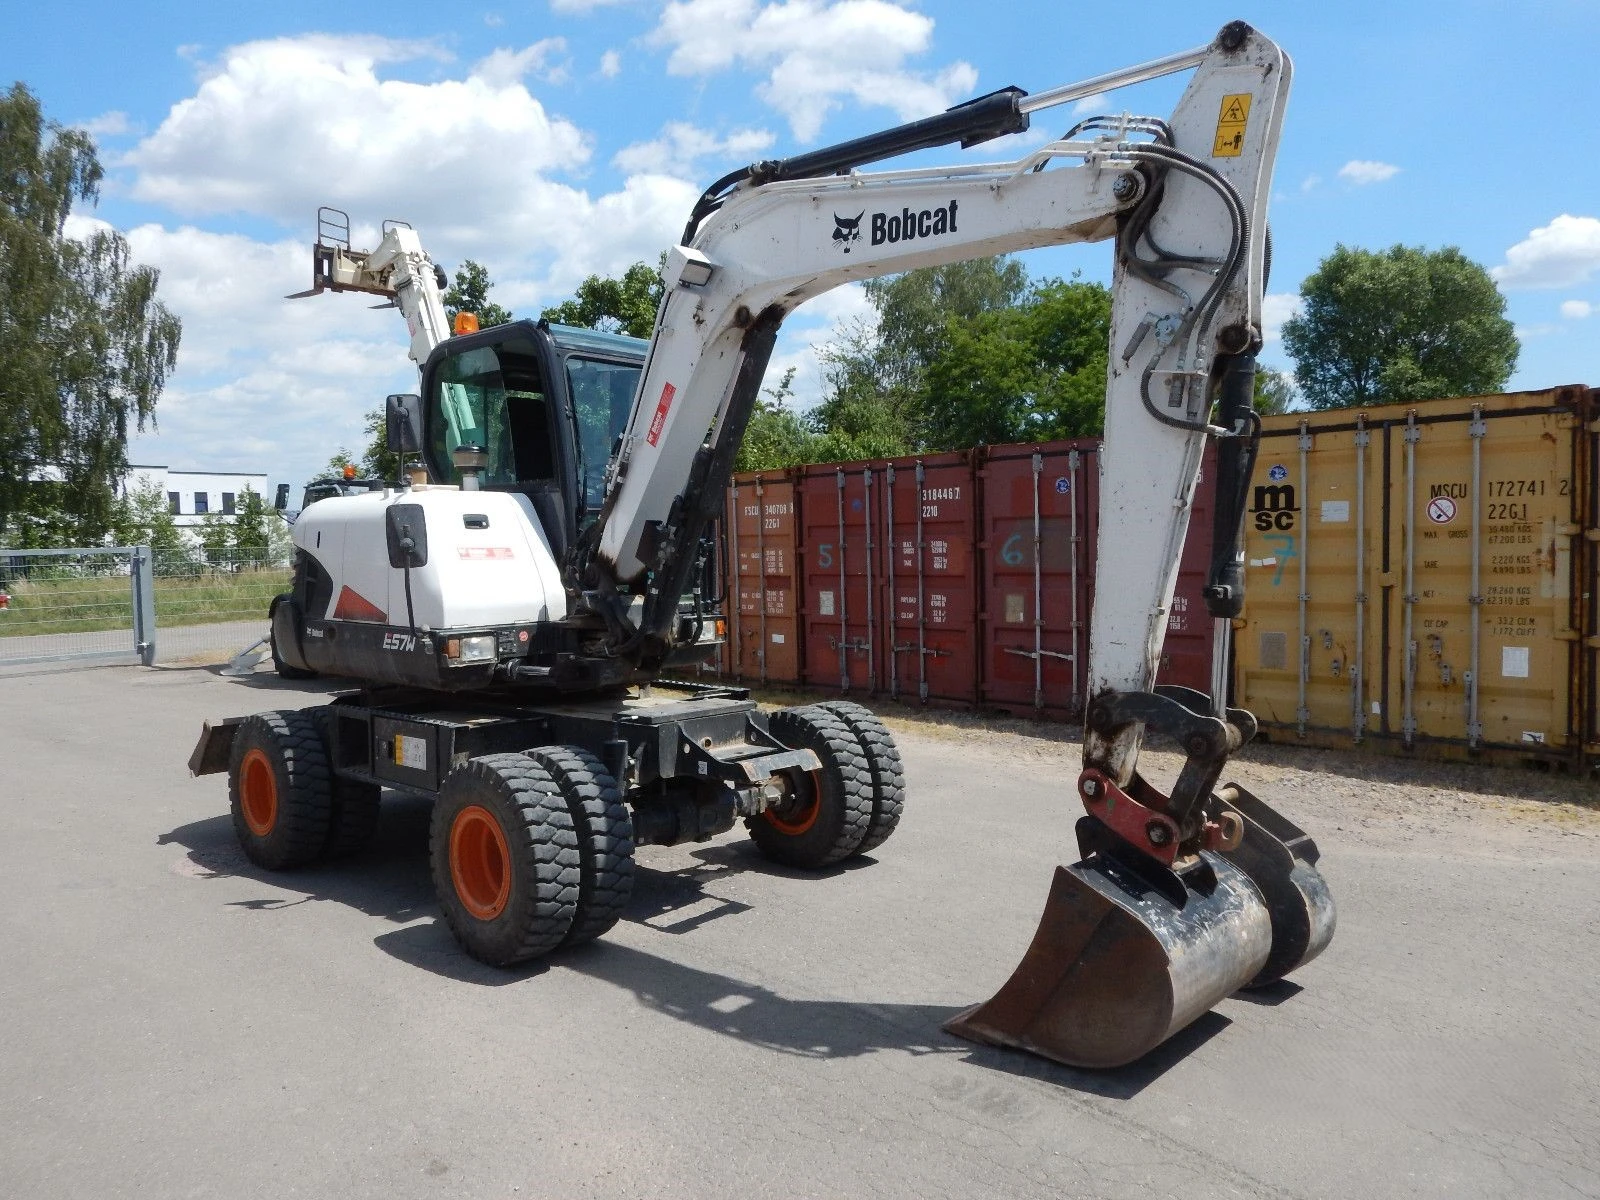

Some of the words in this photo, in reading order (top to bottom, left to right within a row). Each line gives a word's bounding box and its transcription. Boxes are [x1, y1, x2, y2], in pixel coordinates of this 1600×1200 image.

[871, 199, 957, 246] Bobcat
[1430, 483, 1467, 499] MSCU
[1488, 480, 1545, 496] 172741
[1559, 479, 1569, 495] 2
[744, 505, 759, 516] FSCU
[922, 505, 938, 518] 2210
[1487, 503, 1527, 519] 22G1
[765, 518, 780, 529] 22G1
[1447, 530, 1469, 539] GROSS
[817, 543, 834, 569] 5
[1001, 534, 1024, 566] 6
[1263, 533, 1297, 586] 7
[1423, 560, 1439, 569] TARE
[1423, 589, 1435, 598] NET
[382, 632, 416, 652] E57W
